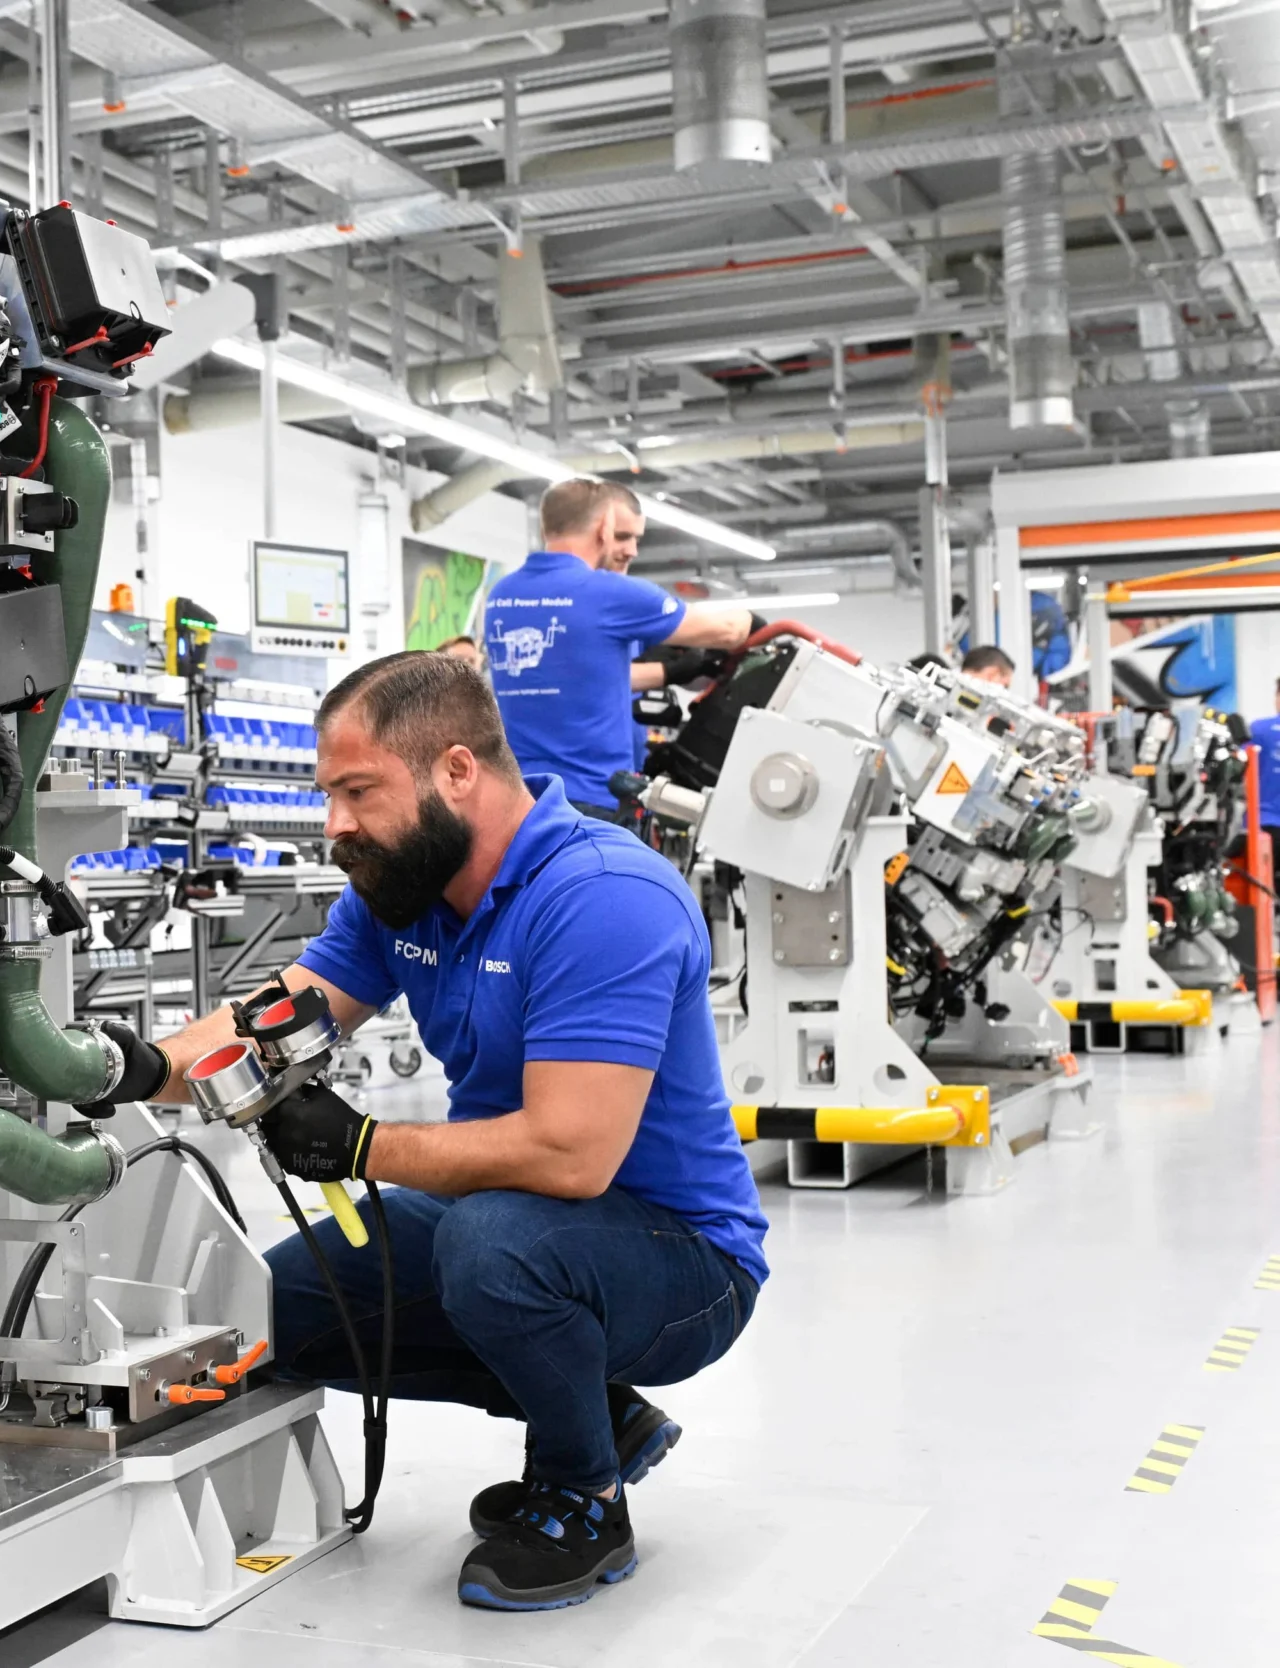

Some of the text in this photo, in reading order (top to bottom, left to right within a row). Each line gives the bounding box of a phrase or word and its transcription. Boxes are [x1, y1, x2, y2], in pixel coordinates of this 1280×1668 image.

[514, 597, 540, 608] Power
[541, 596, 574, 607] Module
[394, 938, 438, 967] FCPM
[485, 959, 511, 974] BOSCH
